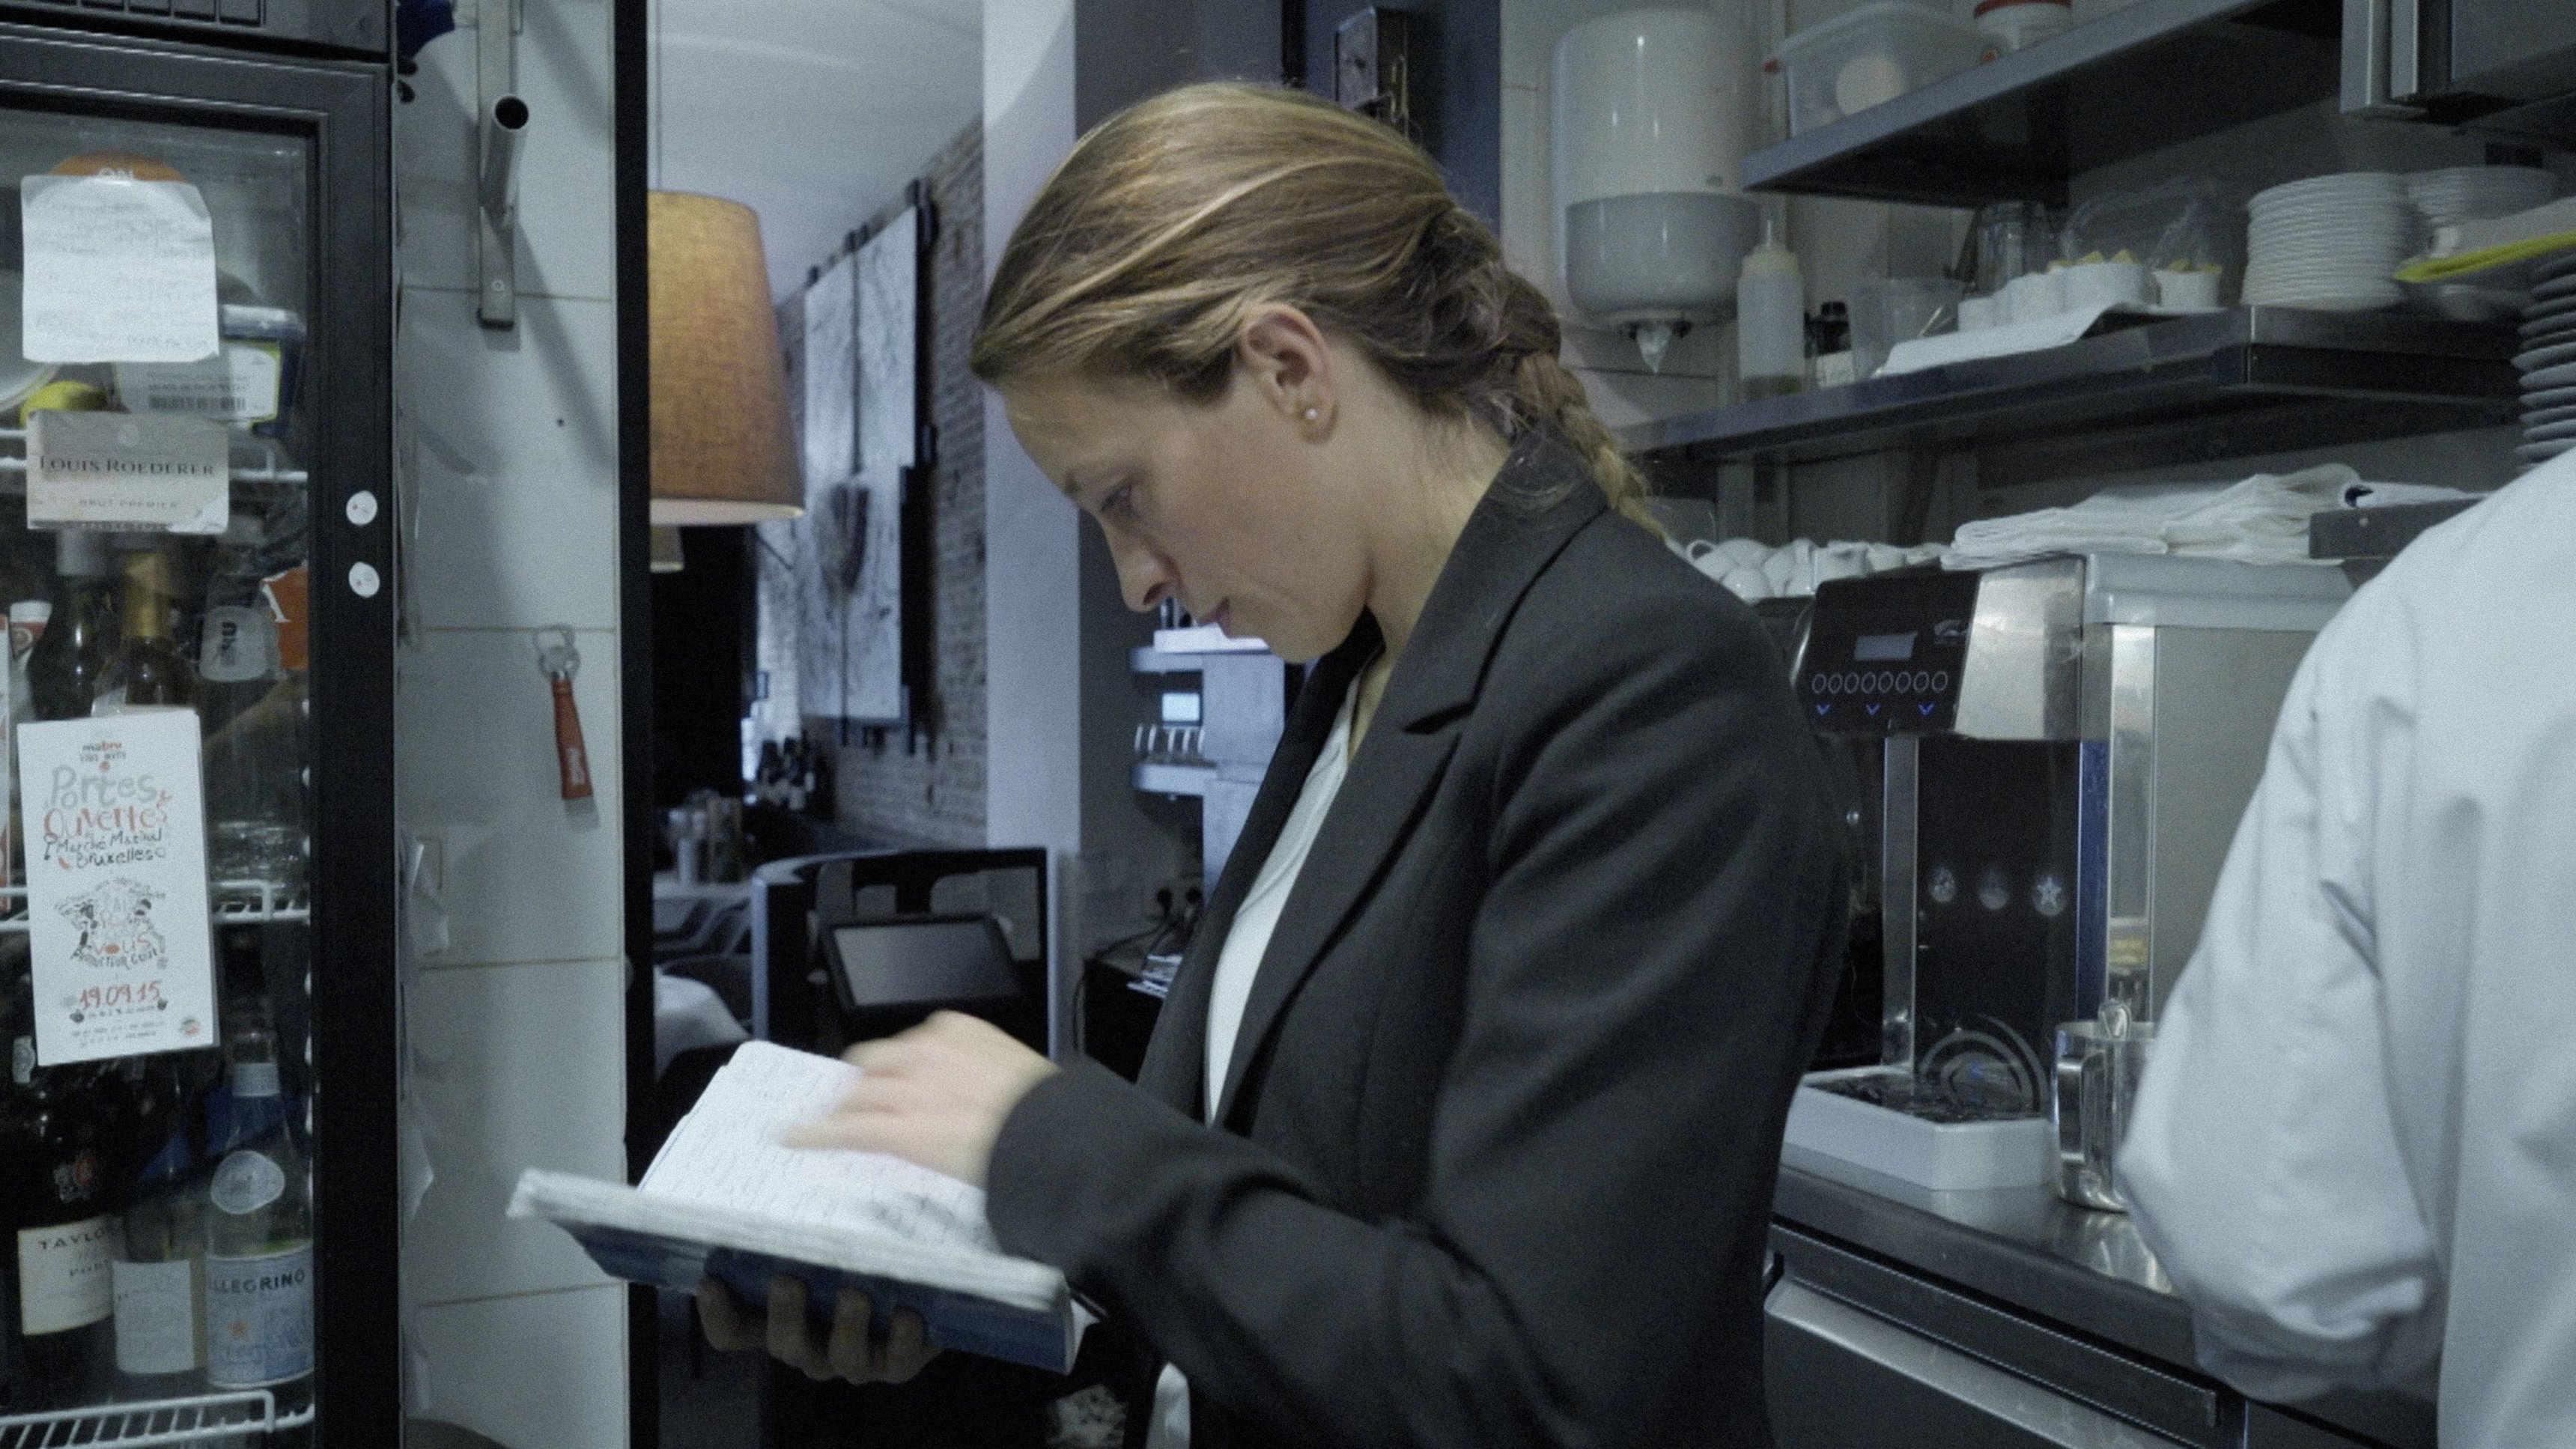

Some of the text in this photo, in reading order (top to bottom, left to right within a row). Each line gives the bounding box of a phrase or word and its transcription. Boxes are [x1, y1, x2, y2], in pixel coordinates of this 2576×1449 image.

[40, 455, 215, 476] LOUIS ROEDERER
[52, 765, 157, 809] Portes
[76, 847, 154, 869] Bruxelles
[209, 1267, 306, 1295] LLEGRINO
